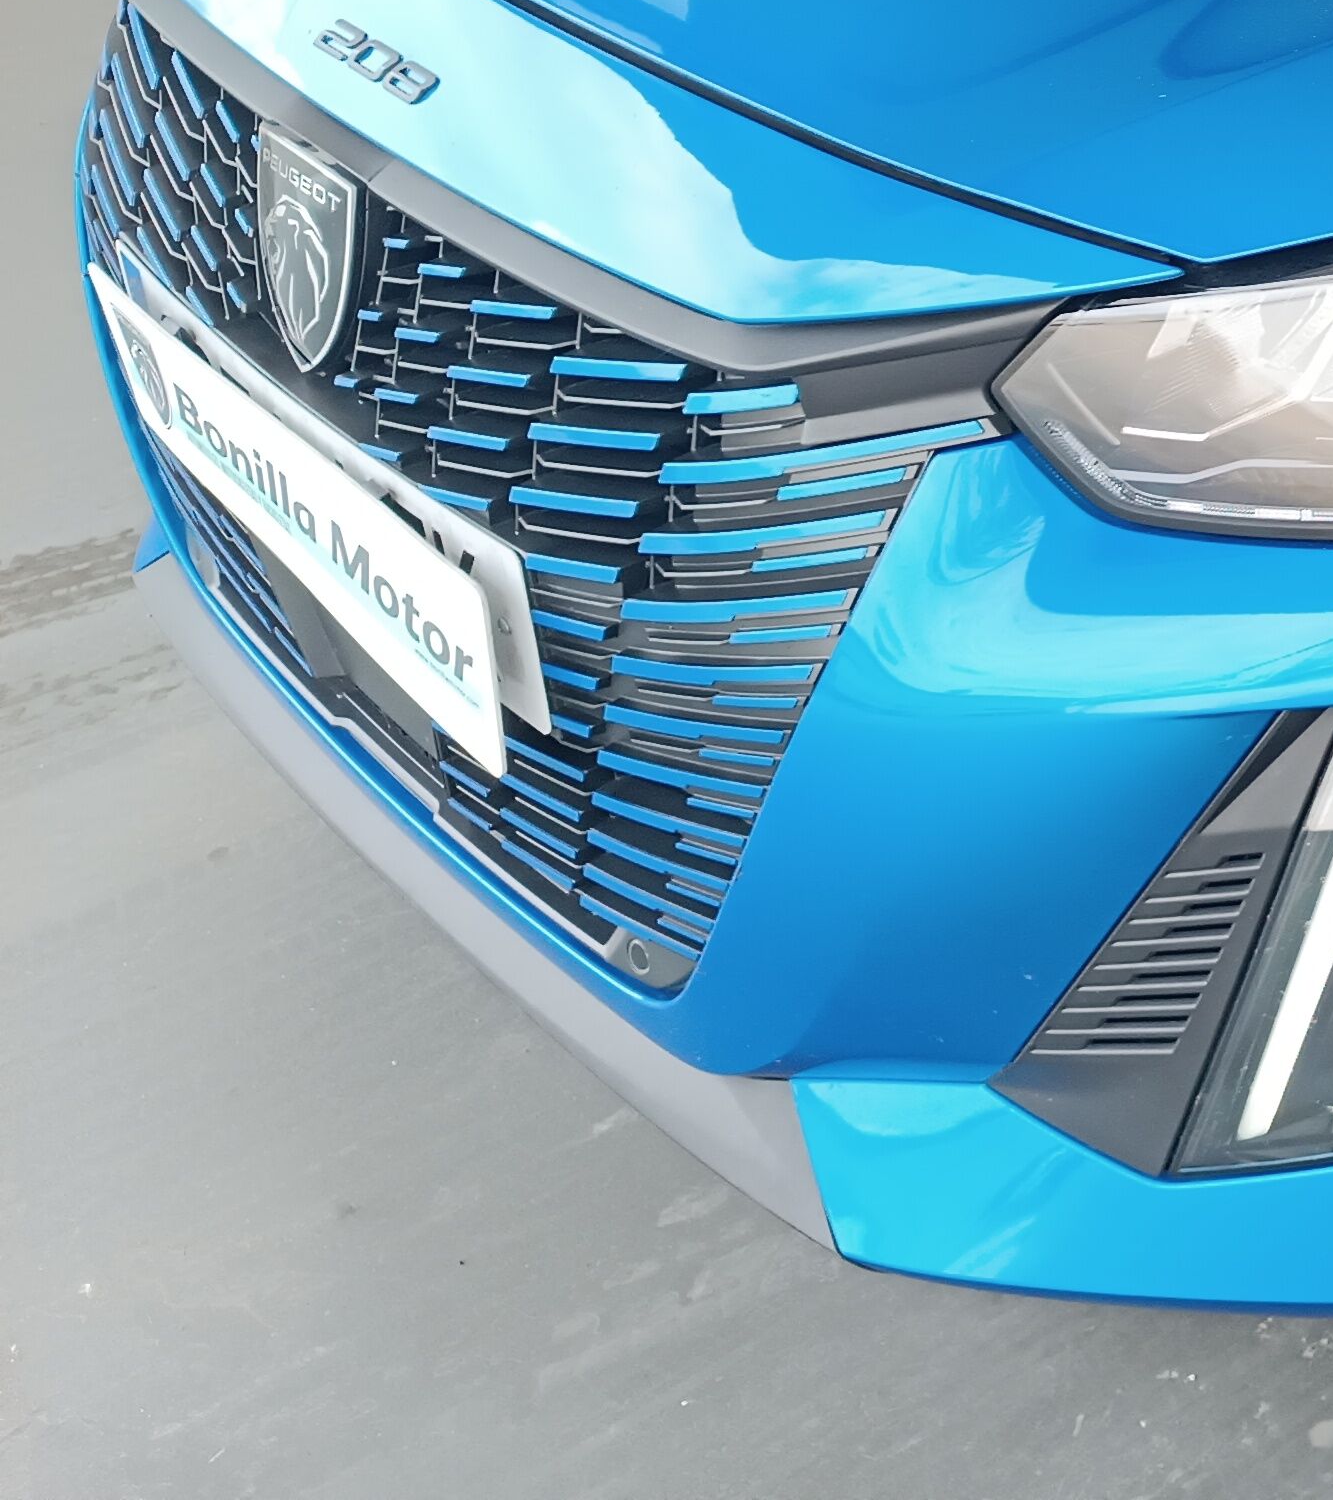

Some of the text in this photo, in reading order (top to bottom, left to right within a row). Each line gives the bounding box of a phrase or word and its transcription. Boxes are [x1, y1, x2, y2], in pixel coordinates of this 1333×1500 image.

[313, 18, 441, 105] 208
[261, 147, 342, 213] PEUGEOT
[173, 382, 317, 544] Bonilla
[331, 519, 473, 682] Motor
